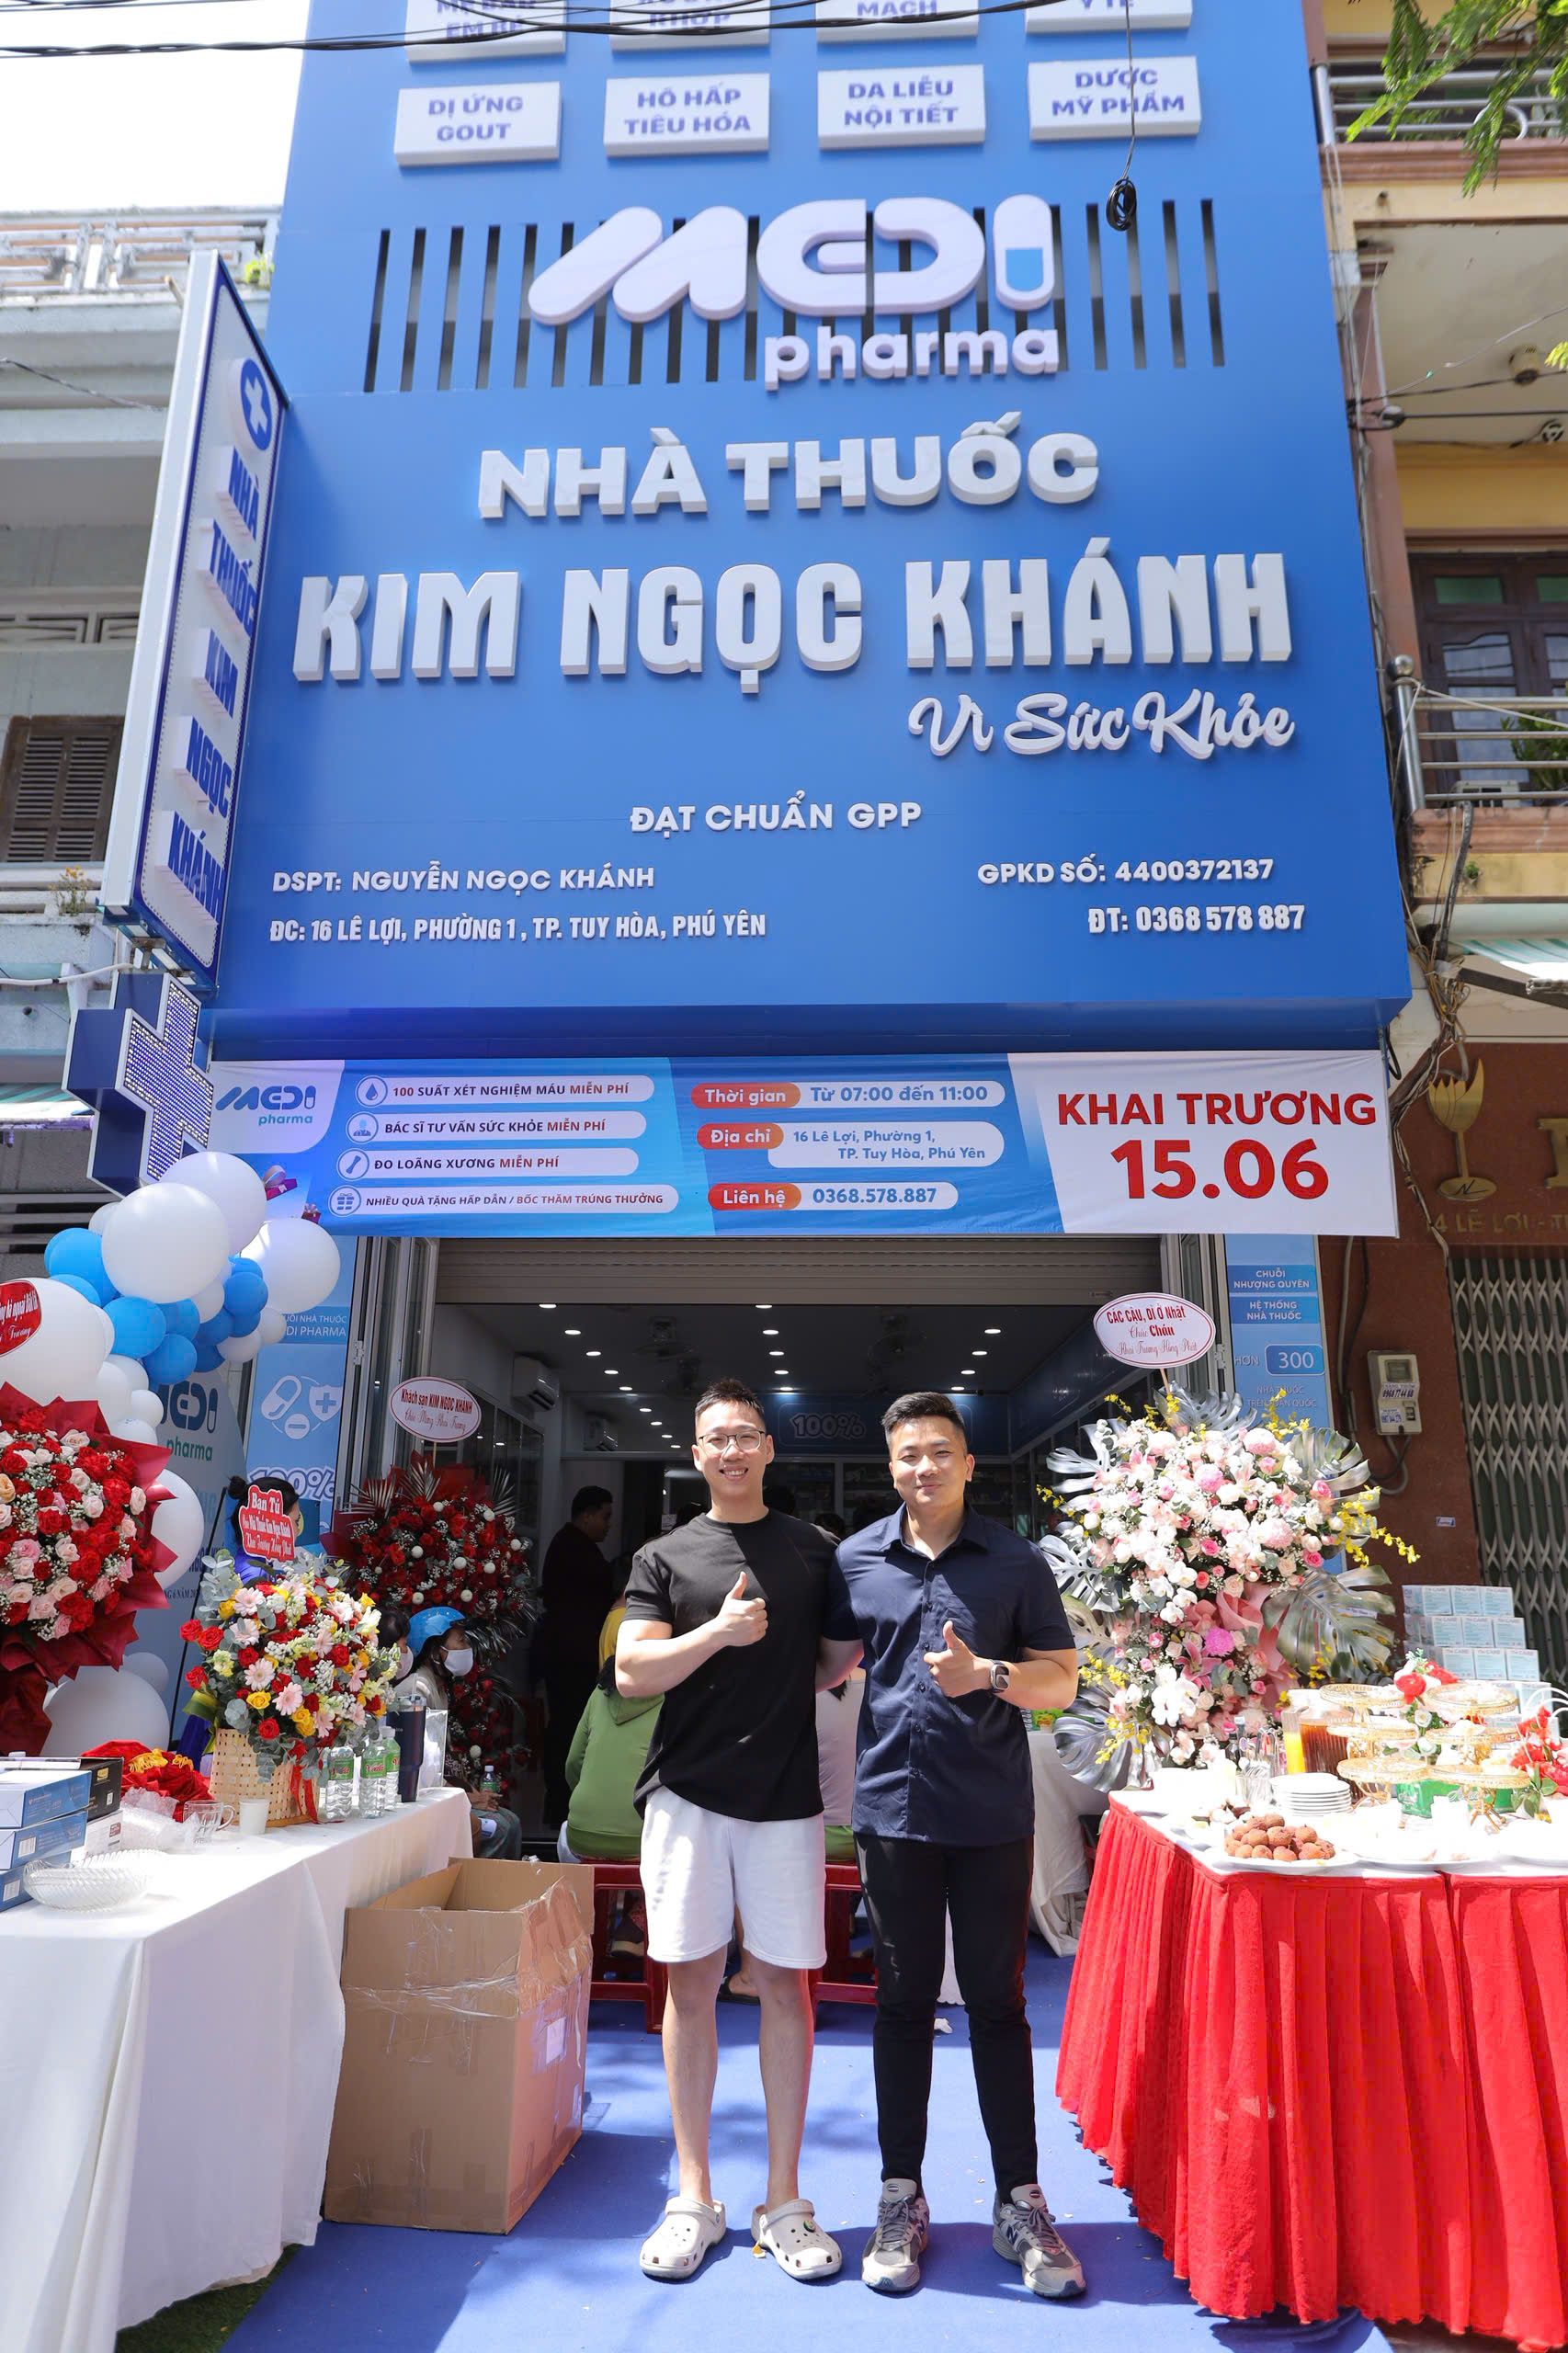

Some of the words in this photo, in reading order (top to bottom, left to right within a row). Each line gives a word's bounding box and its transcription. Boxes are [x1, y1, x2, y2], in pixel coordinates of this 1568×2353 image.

[1075, 67, 1158, 89] DƯỢC
[638, 87, 676, 108] HÔ
[684, 82, 741, 107] HẤP
[848, 82, 885, 99] DA
[428, 99, 455, 119] DỊ
[462, 95, 524, 114] ỨNG
[845, 105, 892, 129] NỘI
[900, 100, 959, 124] TIẾT
[1052, 96, 1093, 116] MỸ
[437, 122, 511, 142] GOUT
[624, 115, 685, 135] TIÊU
[693, 111, 751, 132] HÓA
[528, 194, 1054, 325] MEDI
[765, 325, 1059, 391] pharma
[477, 426, 708, 520] NHÀ
[725, 411, 1099, 513] THUỐC
[228, 444, 260, 541] NHÀ
[292, 571, 521, 682] KIM
[560, 563, 862, 694] NGỌC
[905, 537, 1292, 668] KHÁNH
[204, 628, 238, 719] KIM
[186, 715, 232, 819] NGỌC
[630, 805, 696, 838] ĐẠT
[705, 790, 834, 832] CHUẨN
[847, 801, 922, 830] GPP
[167, 810, 226, 925] KHÁNH
[272, 870, 342, 892] DSPT:
[351, 859, 459, 892] NGUYỄN
[466, 869, 551, 897] NGỌC
[559, 861, 655, 891] KHÁNH
[977, 862, 1054, 885] GPKD
[1060, 853, 1108, 883] SỐ:
[1114, 858, 1275, 882] 4400372137
[269, 919, 306, 943] ĐC:
[311, 917, 333, 941] 16
[337, 914, 362, 941] LÊ
[369, 915, 407, 946] LỢI,
[414, 912, 502, 942] PHƯỜNG
[532, 917, 562, 940] TP.
[570, 916, 610, 939] TUY
[615, 910, 668, 941] HÒA,
[672, 909, 718, 938] PHÚ
[722, 908, 767, 938] YÊN
[1087, 906, 1129, 934] ĐT:
[1136, 905, 1201, 933] 0368
[1206, 904, 1254, 932] 578
[1257, 904, 1306, 931] 887
[392, 1087, 415, 1097] 100
[417, 1083, 451, 1097] SUẤT
[453, 1083, 477, 1097] XÉT
[480, 1083, 532, 1098] NGHIỆM
[536, 1082, 566, 1096] MÁU
[569, 1078, 603, 1095] MIỄN
[607, 1082, 630, 1094] PHÍ
[705, 1087, 744, 1103] Thời
[749, 1089, 787, 1106] gian
[811, 1087, 835, 1101] Từ
[840, 1086, 893, 1101] 07:00
[899, 1084, 935, 1101] đến
[939, 1086, 988, 1101] 11:00
[1058, 1093, 1165, 1125] KHAI
[1177, 1090, 1377, 1125] TRƯƠNG
[258, 1113, 313, 1127] pharma
[384, 1120, 410, 1133] BÁC
[412, 1120, 425, 1133] SĨ
[426, 1121, 447, 1133] TƯ
[449, 1118, 476, 1132] VẤN
[478, 1119, 506, 1133] SỨC
[508, 1119, 544, 1132] KHỎE
[547, 1117, 580, 1131] MIỄN
[584, 1119, 606, 1131] PHÍ
[710, 1129, 741, 1146] Địa
[745, 1128, 771, 1143] chỉ
[793, 1131, 809, 1142] 16
[812, 1130, 829, 1142] Lê
[833, 1131, 860, 1146] Lợi,
[864, 1130, 922, 1145] Phường
[926, 1131, 936, 1144] 1,
[374, 1159, 393, 1169] ĐO
[397, 1155, 442, 1170] LOÃNG
[446, 1157, 495, 1169] XƯƠNG
[499, 1154, 533, 1168] MIỄN
[537, 1155, 560, 1168] PHÍ
[838, 1148, 858, 1159] TP.
[862, 1148, 887, 1163] Tuy
[892, 1146, 924, 1162] Hòa,
[928, 1147, 956, 1159] Phú
[960, 1146, 986, 1159] Yên
[1110, 1139, 1329, 1199] 15.06
[366, 1195, 399, 1206] NHIỀU
[402, 1194, 425, 1207] QUÀ
[427, 1195, 457, 1208] TẶNG
[460, 1192, 482, 1206] HẤP
[483, 1193, 507, 1205] DẪN
[517, 1191, 539, 1205] BỐC
[541, 1194, 573, 1204] THĂM
[575, 1192, 612, 1204] TRÚNG
[615, 1191, 664, 1204] THƯỞNG
[723, 1188, 760, 1205] Liên
[765, 1188, 787, 1208] hệ
[812, 1188, 937, 1204] 0368.578.887
[1256, 1267, 1286, 1278] CHUỖI
[1233, 1279, 1276, 1290] NHƯỢNG
[1278, 1279, 1310, 1288] QUYỀN
[1107, 1308, 1124, 1324] CÁC
[1246, 1311, 1267, 1320] NHÀ
[1269, 1310, 1302, 1320] THUỐC
[1250, 1300, 1262, 1311] HỆ
[1264, 1299, 1297, 1309] THỐNG
[300, 1326, 347, 1337] PHARMA
[1278, 1352, 1314, 1369] 300
[429, 1393, 439, 1409] KIM
[790, 1414, 866, 1439] 100%
[251, 1492, 267, 1515] Bạn
[268, 1495, 280, 1515] Tú
